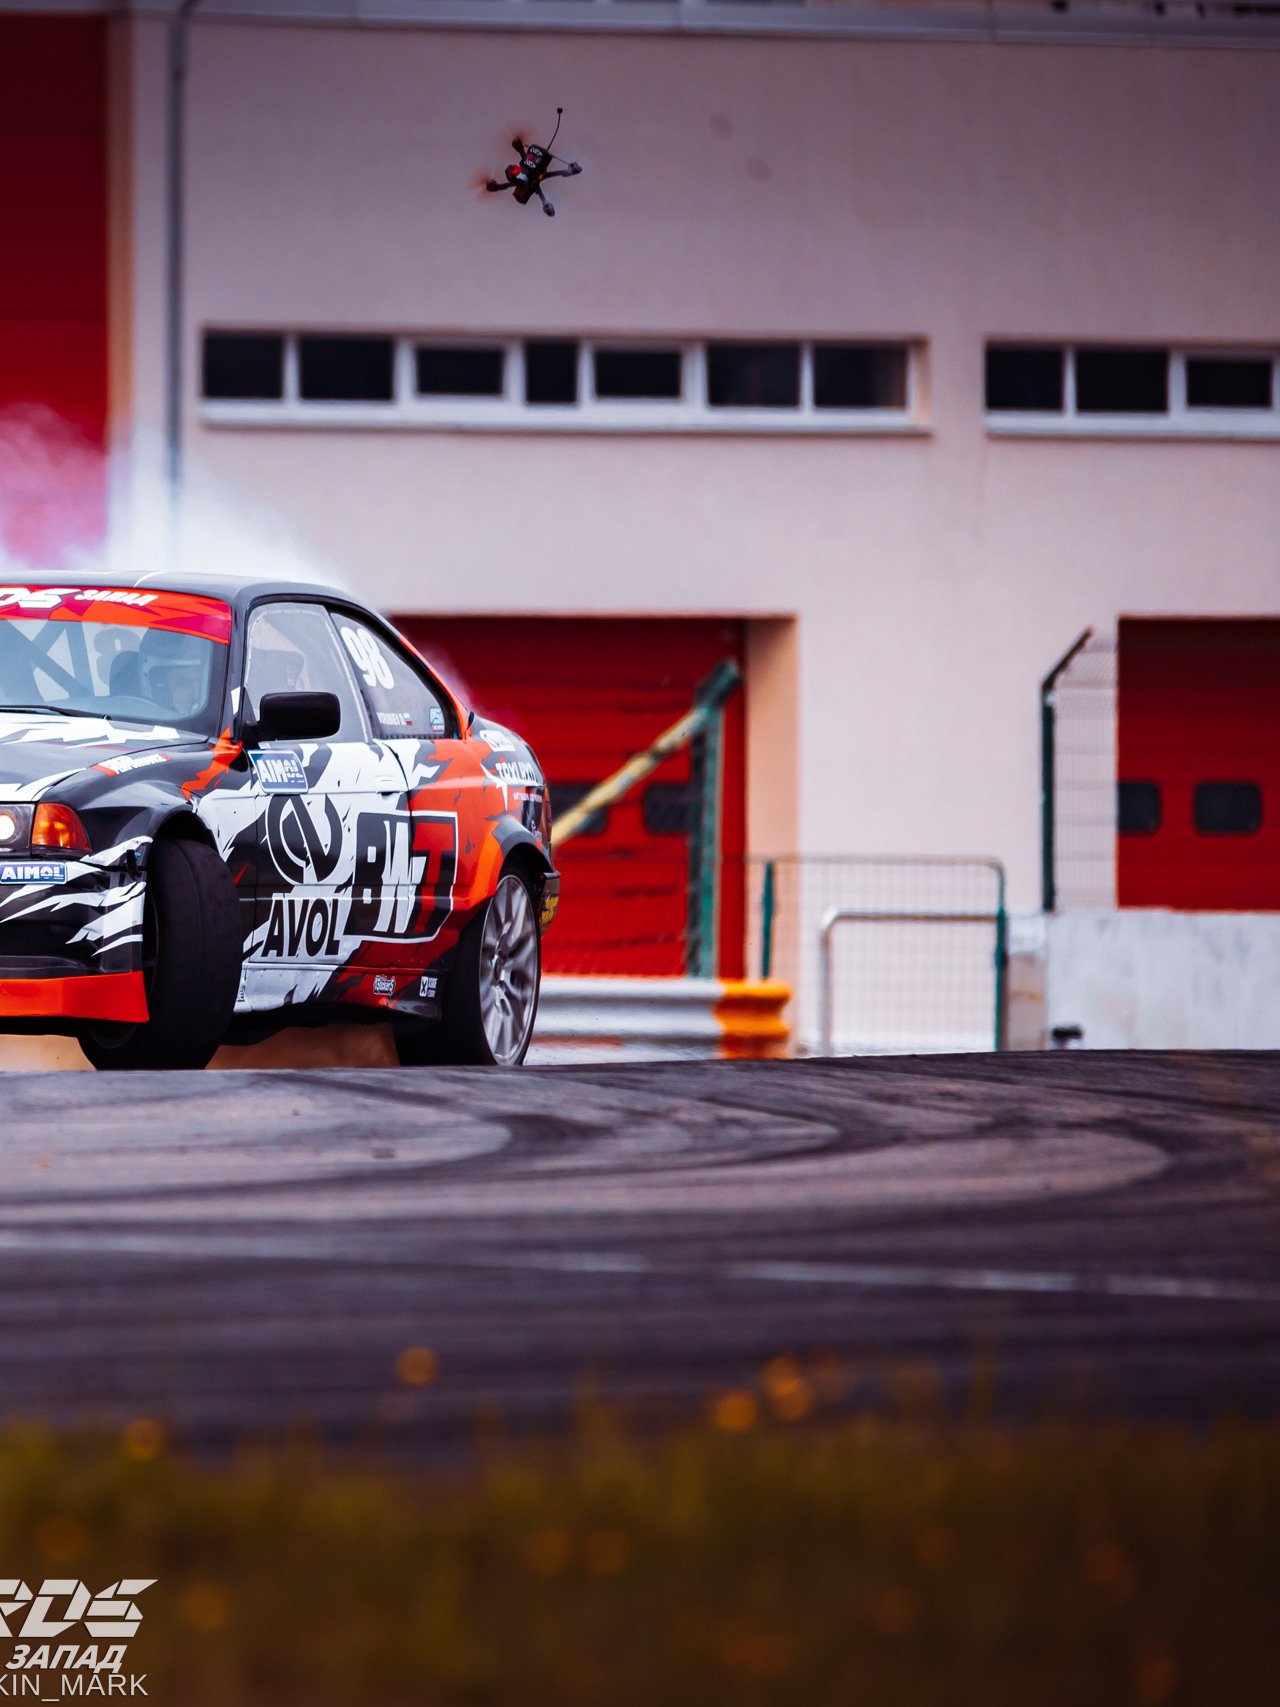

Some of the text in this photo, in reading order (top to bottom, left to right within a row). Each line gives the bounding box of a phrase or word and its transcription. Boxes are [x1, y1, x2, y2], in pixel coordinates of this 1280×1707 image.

[340, 626, 395, 690] 98
[257, 758, 304, 783] AIMOL
[1, 866, 64, 880] AIMOL
[344, 812, 455, 936] BWT
[261, 897, 341, 957] AVOL
